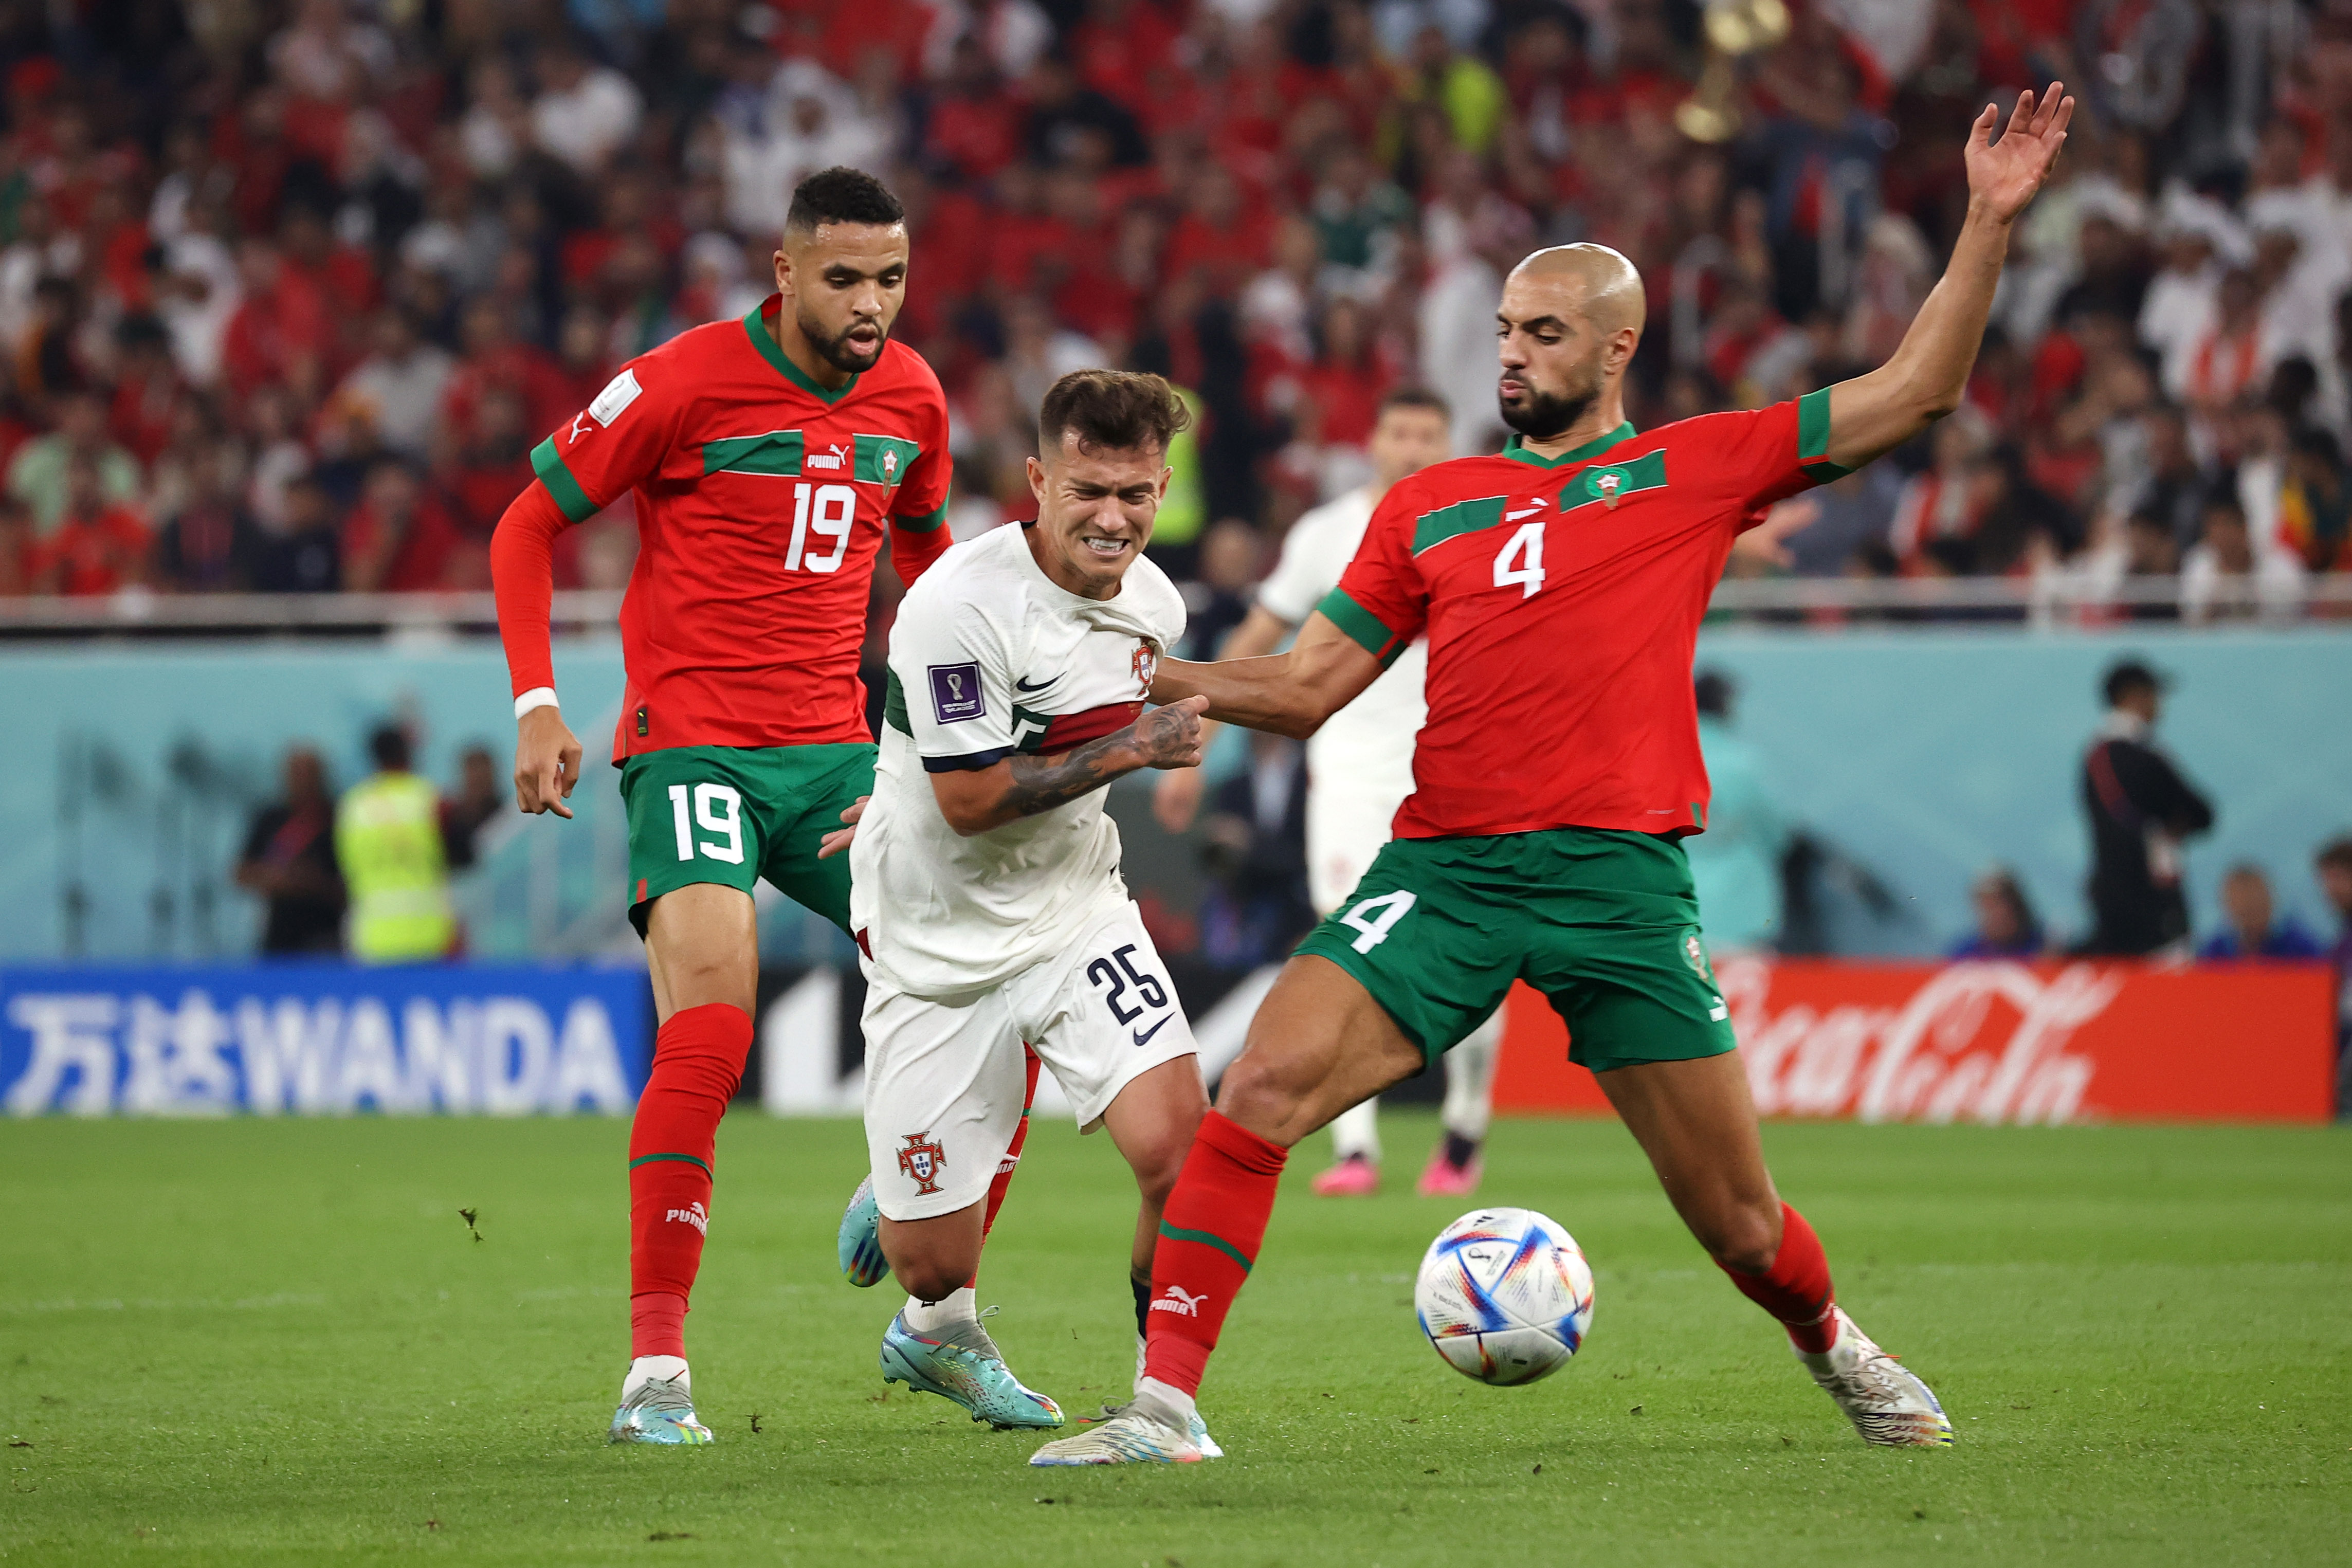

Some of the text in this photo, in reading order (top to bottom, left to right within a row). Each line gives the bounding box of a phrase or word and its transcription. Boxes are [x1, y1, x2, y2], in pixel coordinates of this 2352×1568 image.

[807, 454, 840, 470] PUMA
[784, 483, 856, 573] 19
[1492, 522, 1546, 599] 4
[668, 782, 744, 865] 19
[1339, 890, 1417, 955] 4
[1087, 943, 1168, 1026] 25
[6, 988, 634, 1114] 万达 WANDA
[1150, 1299, 1189, 1315] PUMA
